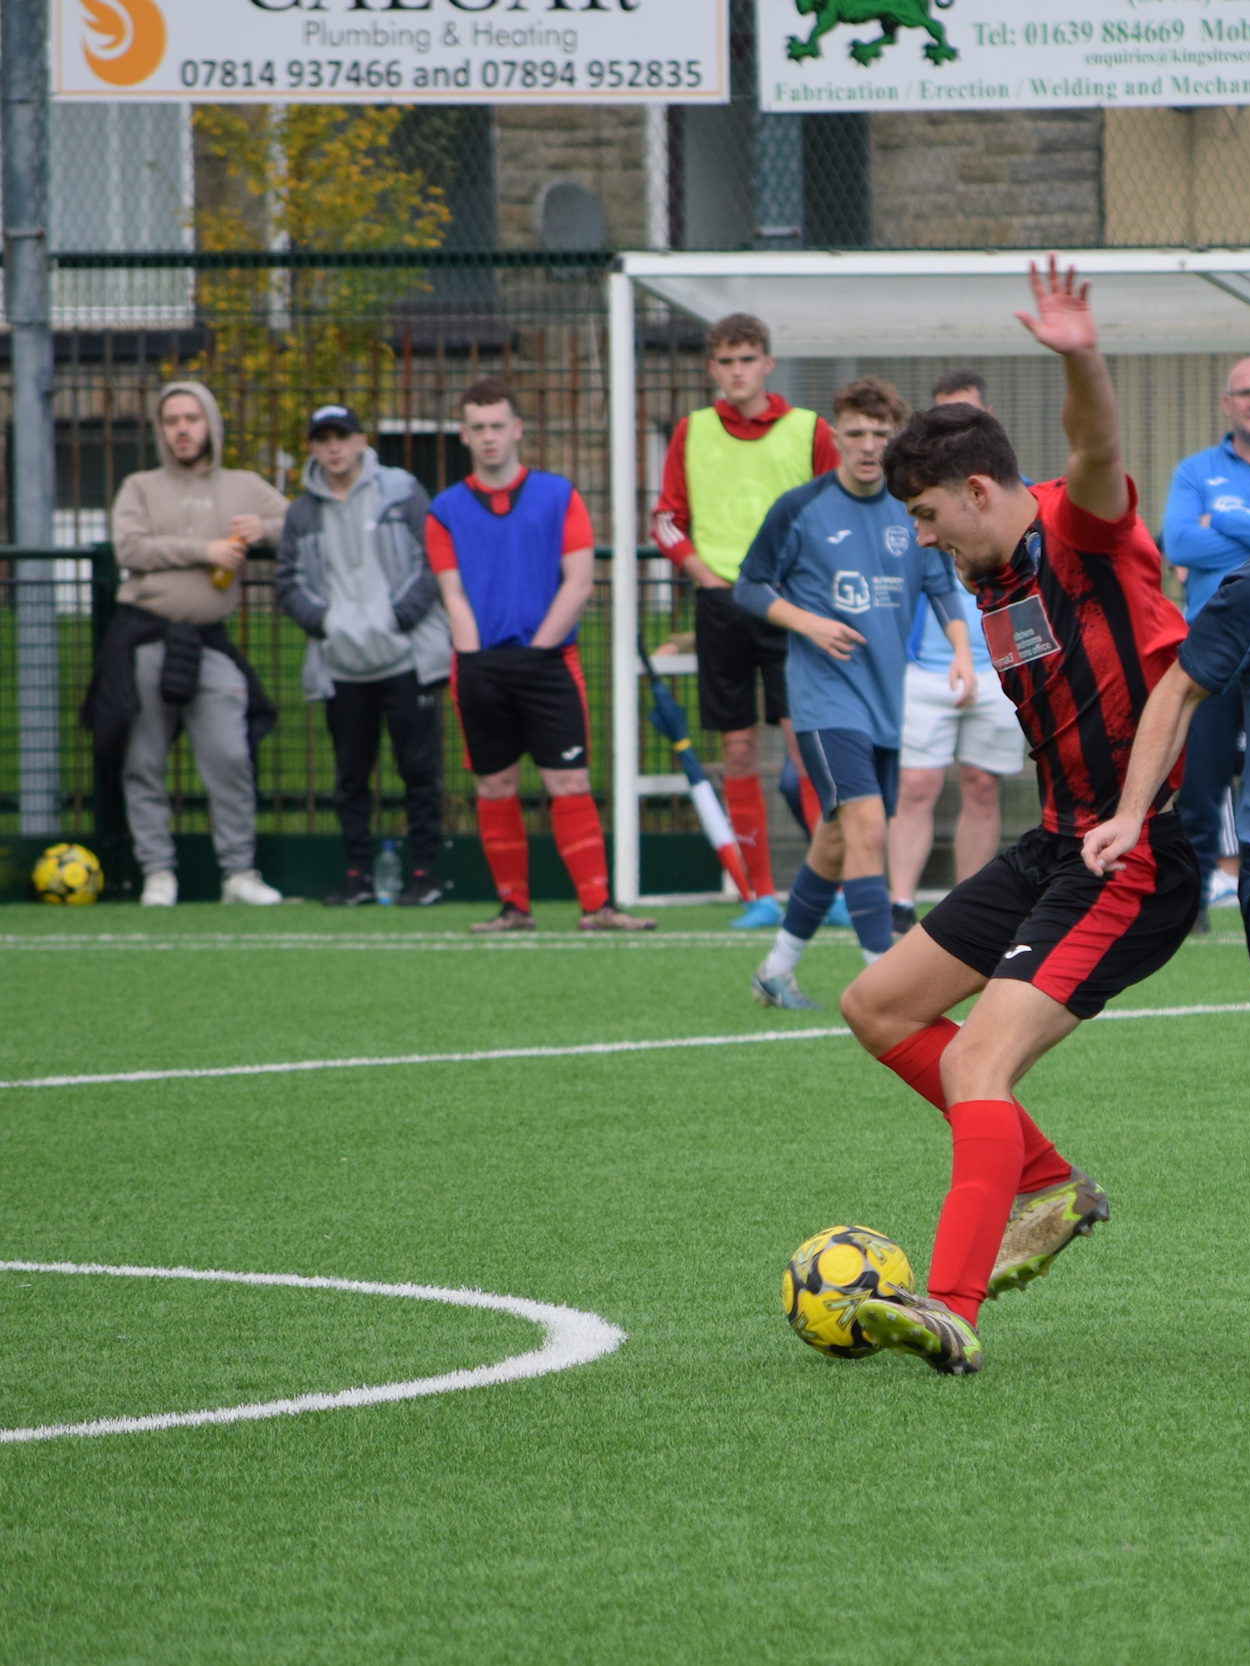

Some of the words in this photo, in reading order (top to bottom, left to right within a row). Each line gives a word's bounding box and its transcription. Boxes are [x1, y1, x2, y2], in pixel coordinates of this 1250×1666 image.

[305, 19, 431, 54] Plumbing
[442, 20, 462, 47] &
[472, 20, 578, 53] Heating
[972, 21, 1016, 47] Tel:
[1024, 20, 1094, 46] 01639
[1102, 18, 1185, 45] 884669
[180, 60, 276, 89] 07814
[287, 60, 403, 88] 937466
[413, 58, 471, 88] and
[482, 59, 577, 88] 07894
[588, 59, 702, 88] 952835
[774, 82, 899, 102] Fabrication
[920, 79, 1010, 99] Erection
[1029, 77, 1118, 100] Welding
[1125, 75, 1163, 96] and
